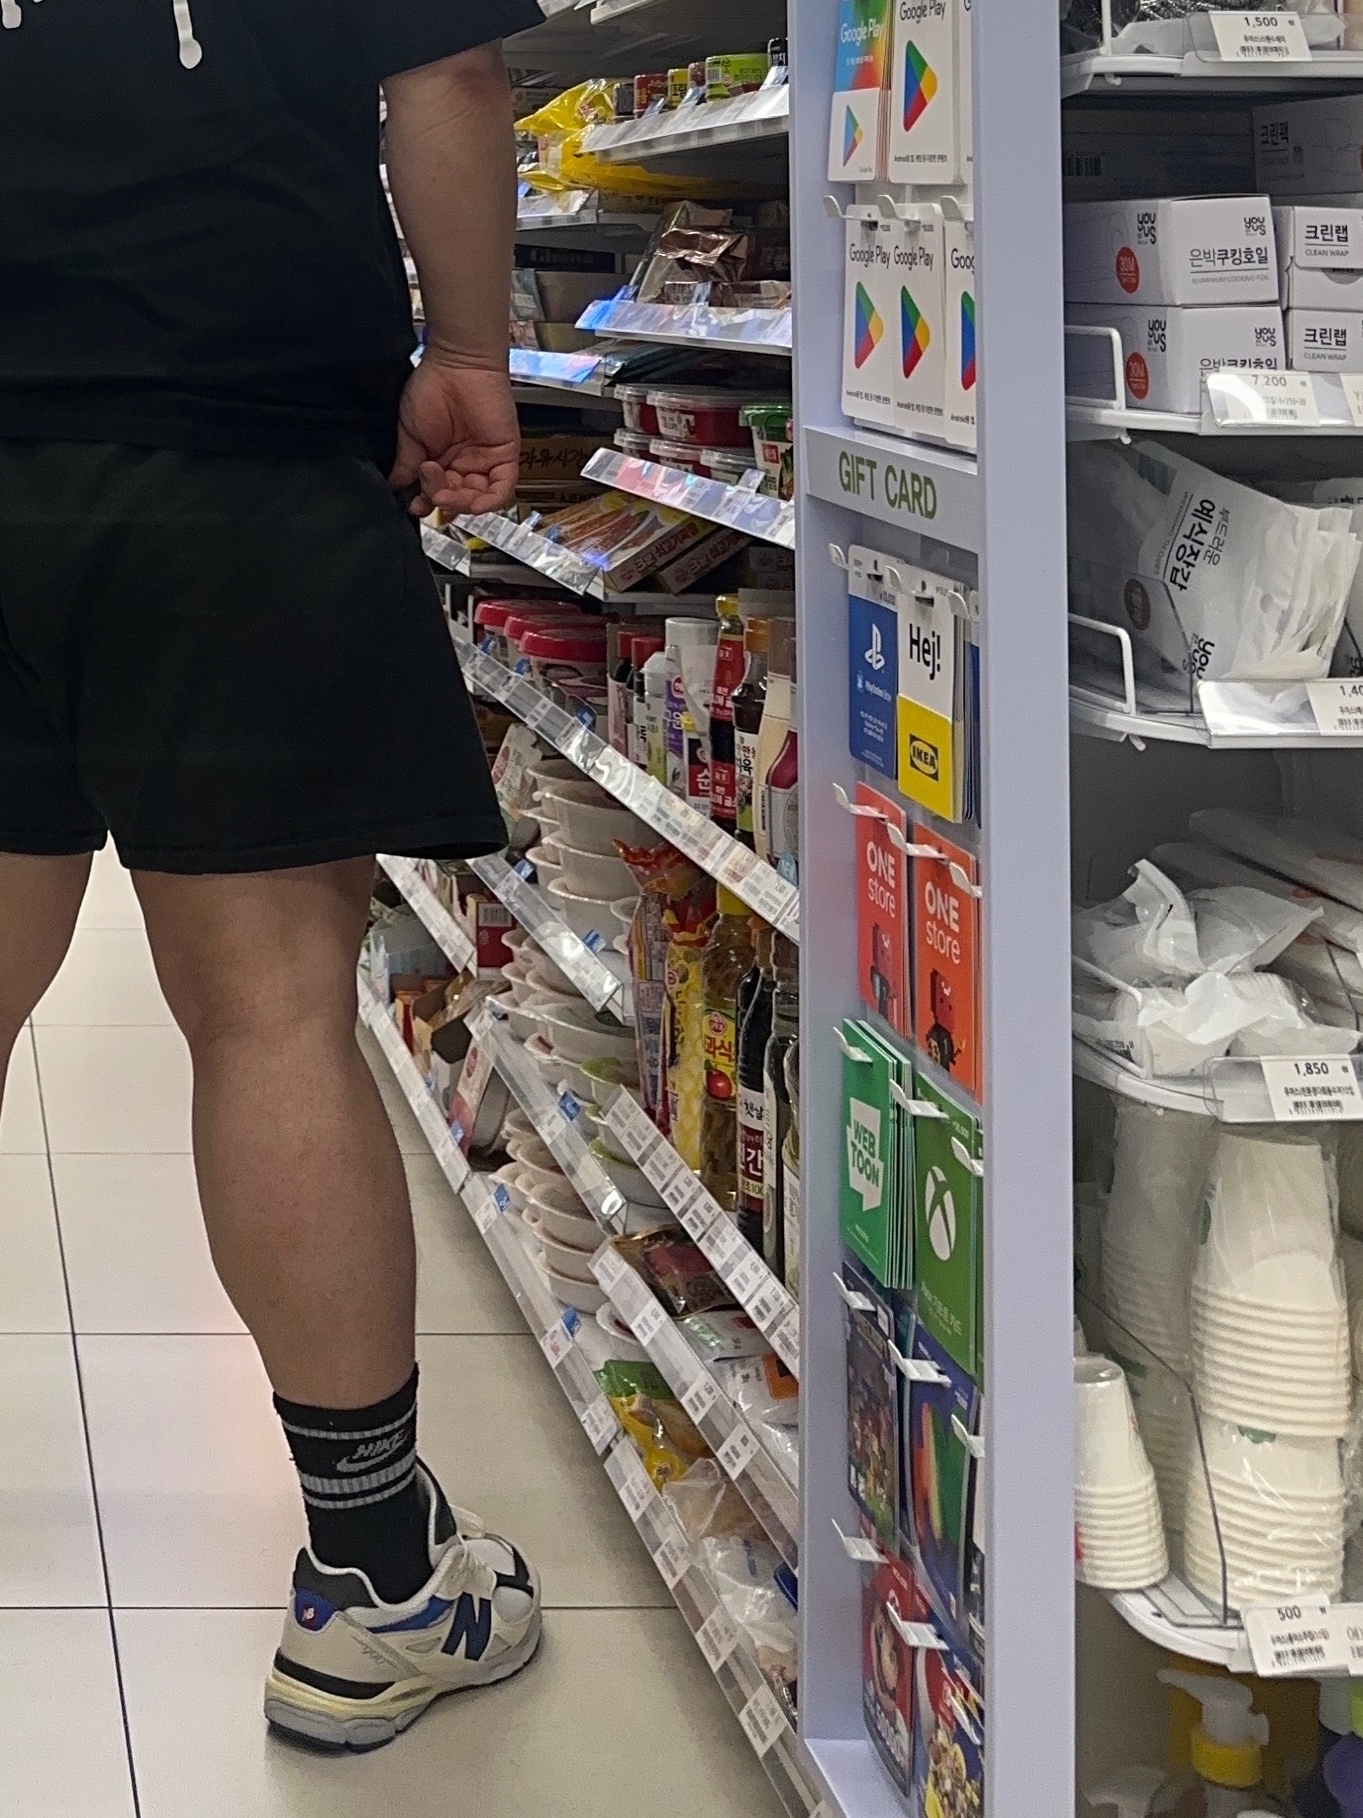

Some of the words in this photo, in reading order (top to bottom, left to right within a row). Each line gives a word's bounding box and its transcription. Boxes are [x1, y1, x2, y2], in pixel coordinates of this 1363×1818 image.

[899, 0, 929, 24] Google
[1243, 16, 1279, 29] 1,500
[840, 21, 868, 47] Google
[868, 18, 884, 42] Play
[1304, 223, 1350, 243] 크린랩
[849, 243, 875, 269] Google
[875, 244, 891, 270] Play
[893, 245, 918, 271] Google
[918, 246, 934, 269] Play
[1188, 246, 1269, 268] 은박쿠킹호일
[1304, 248, 1328, 258] CLEAN
[1329, 249, 1350, 258] WRAP
[1303, 327, 1348, 347] 크린랩
[1303, 351, 1327, 361] CLEAN
[1328, 352, 1348, 361] WRAP
[838, 450, 877, 501] GIFT
[884, 463, 937, 520] CARD
[1169, 497, 1217, 592] 예식장갑
[908, 622, 941, 682] Hej!
[911, 743, 937, 771] IKEA
[866, 840, 896, 889] ONE
[867, 878, 897, 919] store
[924, 880, 961, 934] ONE
[925, 919, 961, 965] store
[1294, 1062, 1330, 1077] 1,850
[852, 1118, 876, 1151] WEB
[850, 1139, 880, 1189] TOON
[352, 1428, 406, 1460] NIKE
[1276, 1604, 1302, 1622] 500
